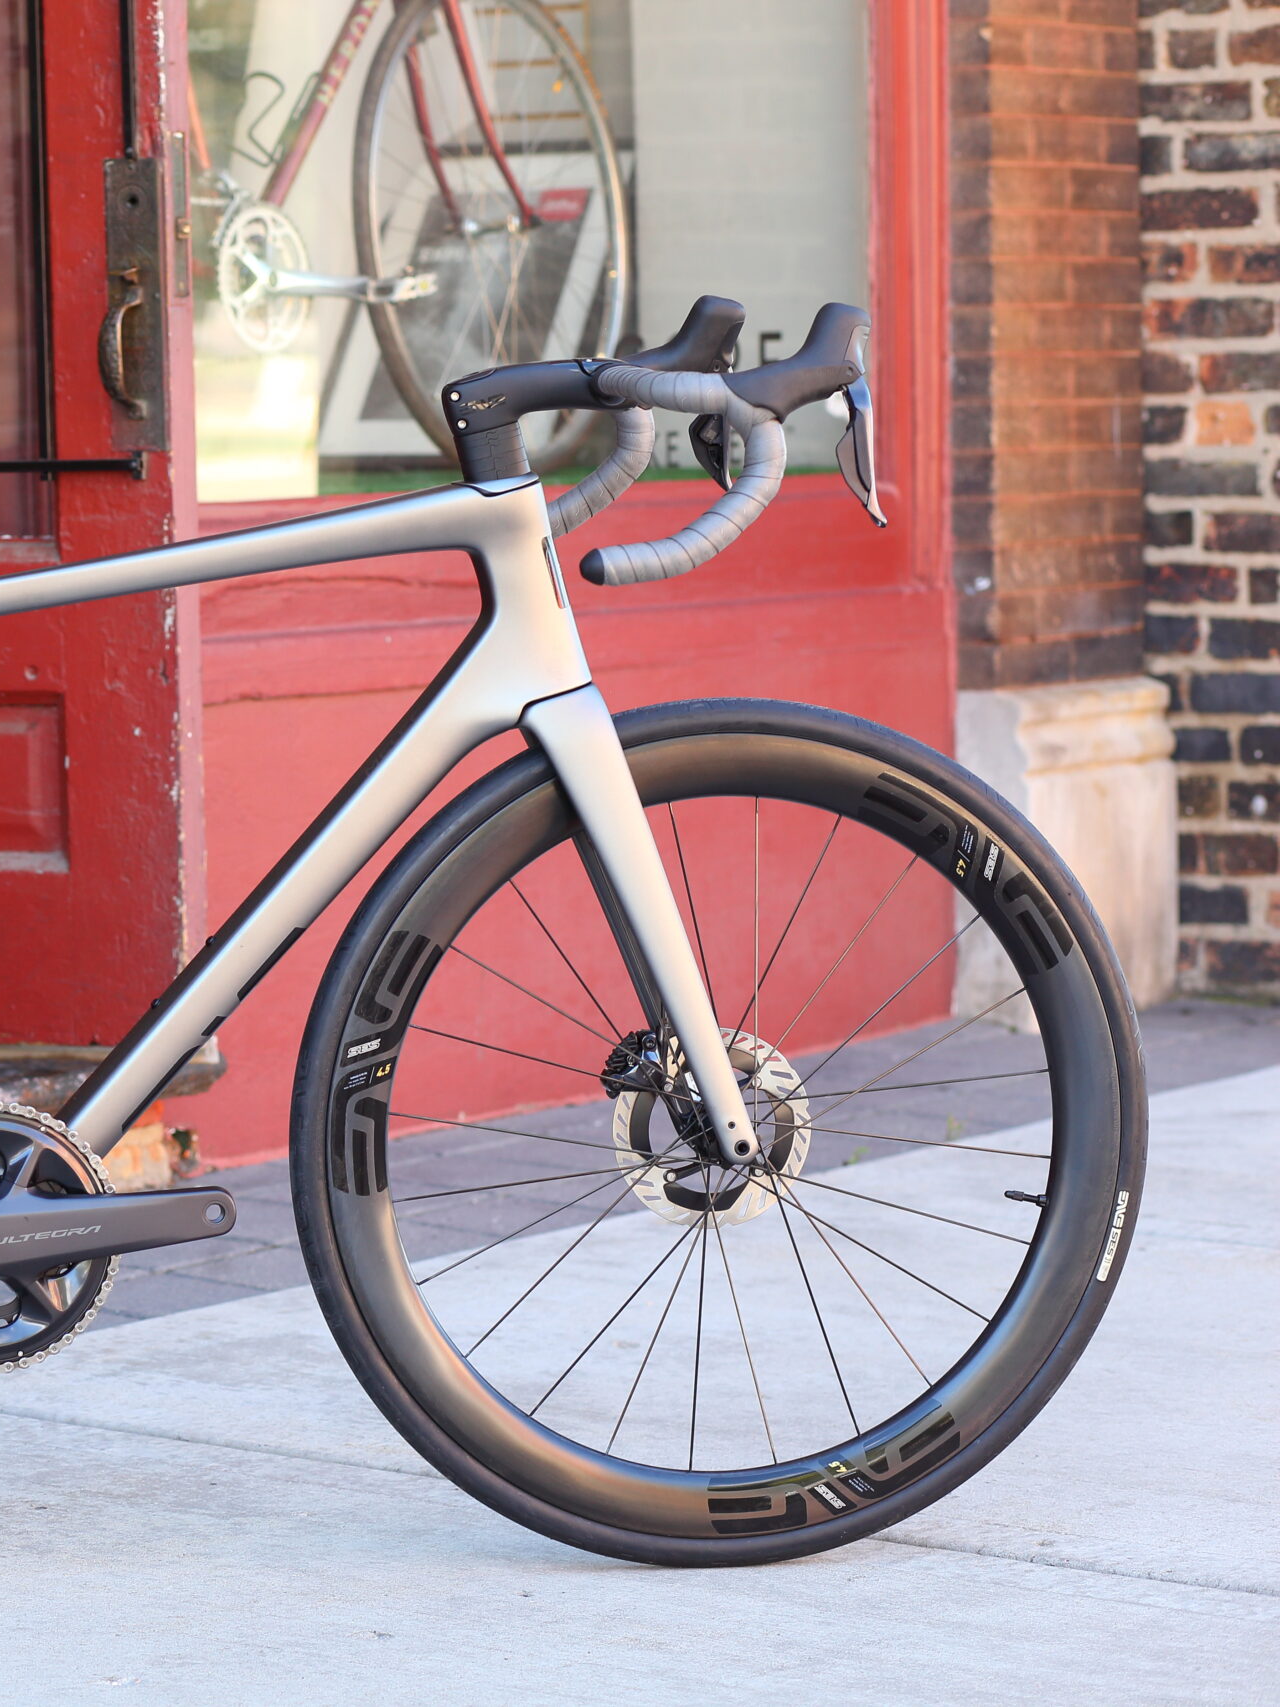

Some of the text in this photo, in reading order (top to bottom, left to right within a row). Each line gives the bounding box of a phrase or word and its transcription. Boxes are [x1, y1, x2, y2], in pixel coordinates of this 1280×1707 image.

[955, 859, 967, 877] 4.5
[376, 1063, 392, 1077] 4.5
[828, 1461, 848, 1473] 4.5
[813, 1484, 847, 1510] SES
